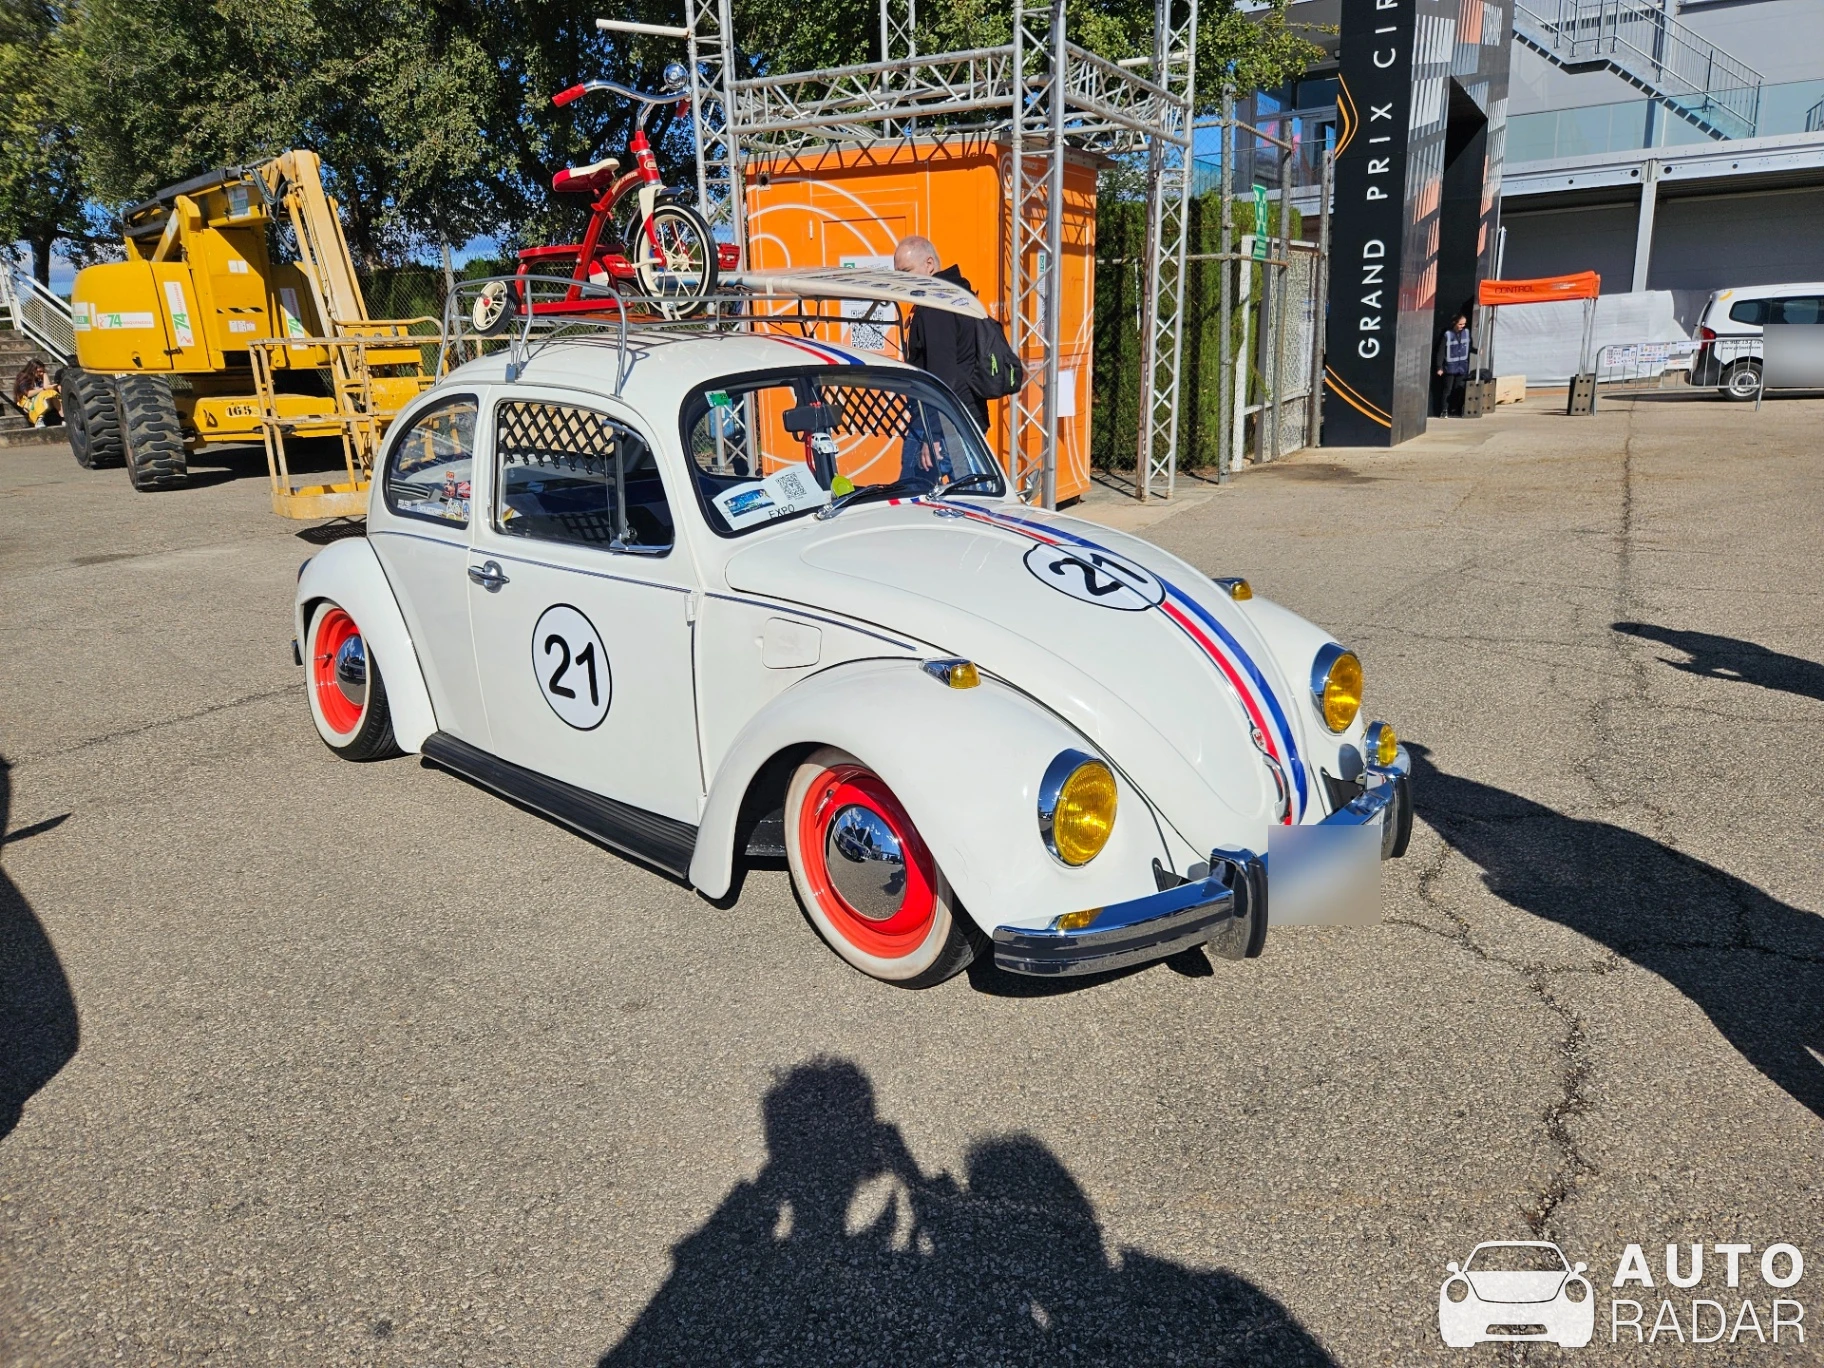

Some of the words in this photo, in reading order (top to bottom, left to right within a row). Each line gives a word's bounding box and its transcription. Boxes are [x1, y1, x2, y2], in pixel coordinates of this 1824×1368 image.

[1366, 102, 1393, 200] PRIX
[1358, 239, 1385, 359] GRAND
[1494, 285, 1535, 295] CONTROL
[107, 313, 122, 328] 74
[172, 312, 190, 330] 74
[227, 405, 252, 417] 165
[768, 504, 795, 519] EXPO
[1048, 553, 1149, 597] 21
[544, 633, 599, 707] 21
